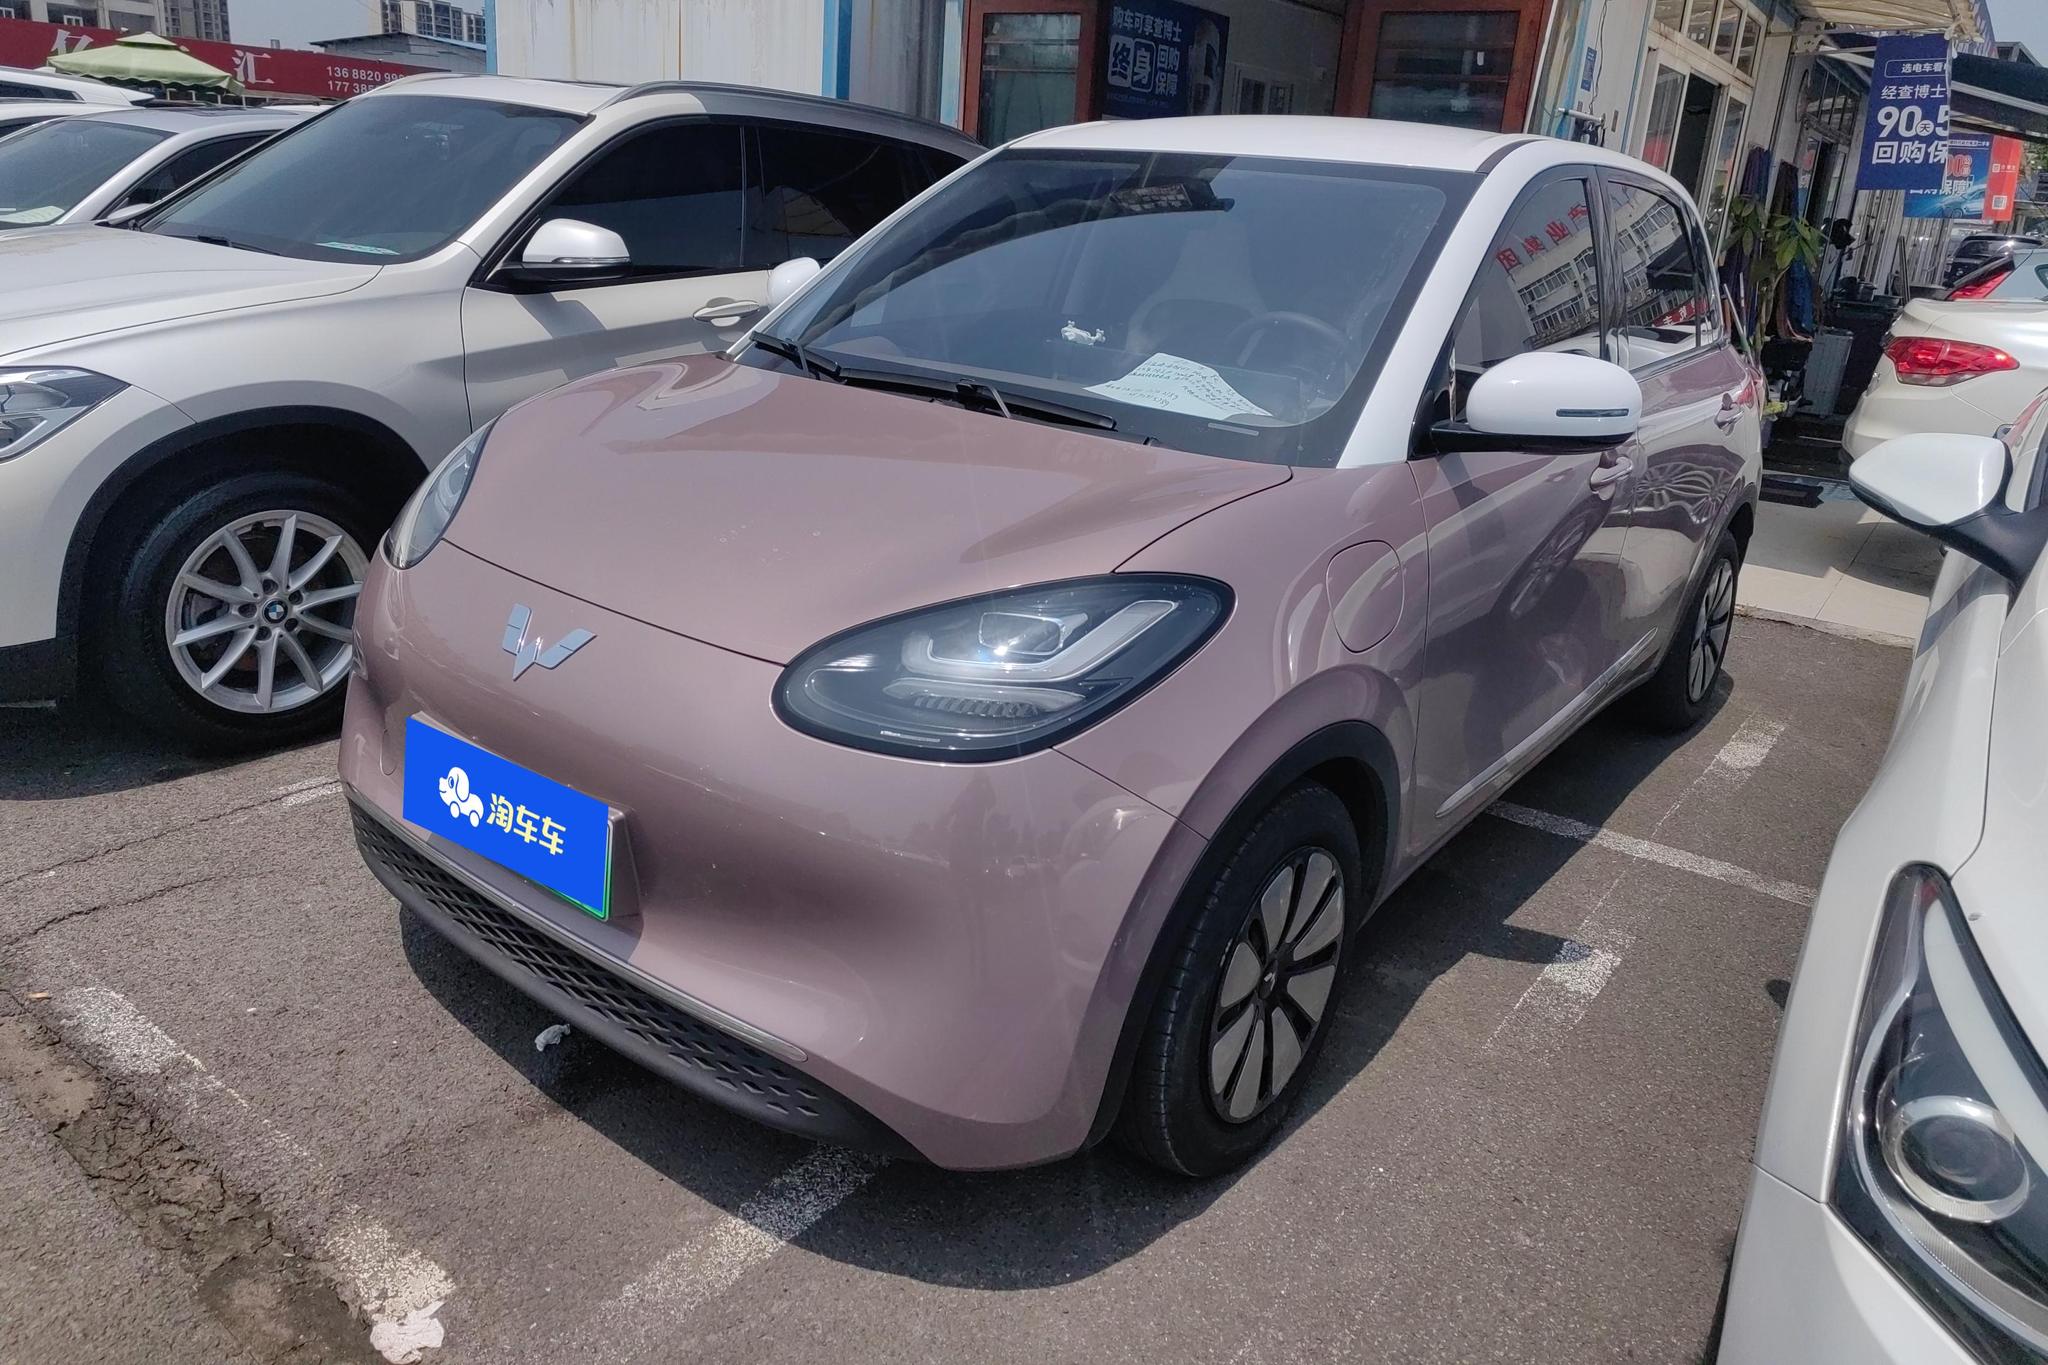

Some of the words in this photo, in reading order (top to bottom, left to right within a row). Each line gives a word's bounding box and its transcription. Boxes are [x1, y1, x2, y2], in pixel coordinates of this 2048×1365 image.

[1113, 6, 1183, 42] 购车可享查博士
[1111, 40, 1152, 86] 终身
[1157, 44, 1180, 72] 回购
[1901, 62, 1947, 73] 选电车看
[326, 66, 349, 78] 136
[351, 68, 382, 82] 8820
[1155, 71, 1179, 96] 保障
[328, 80, 350, 92] 177
[1880, 84, 1948, 99] 经查博士
